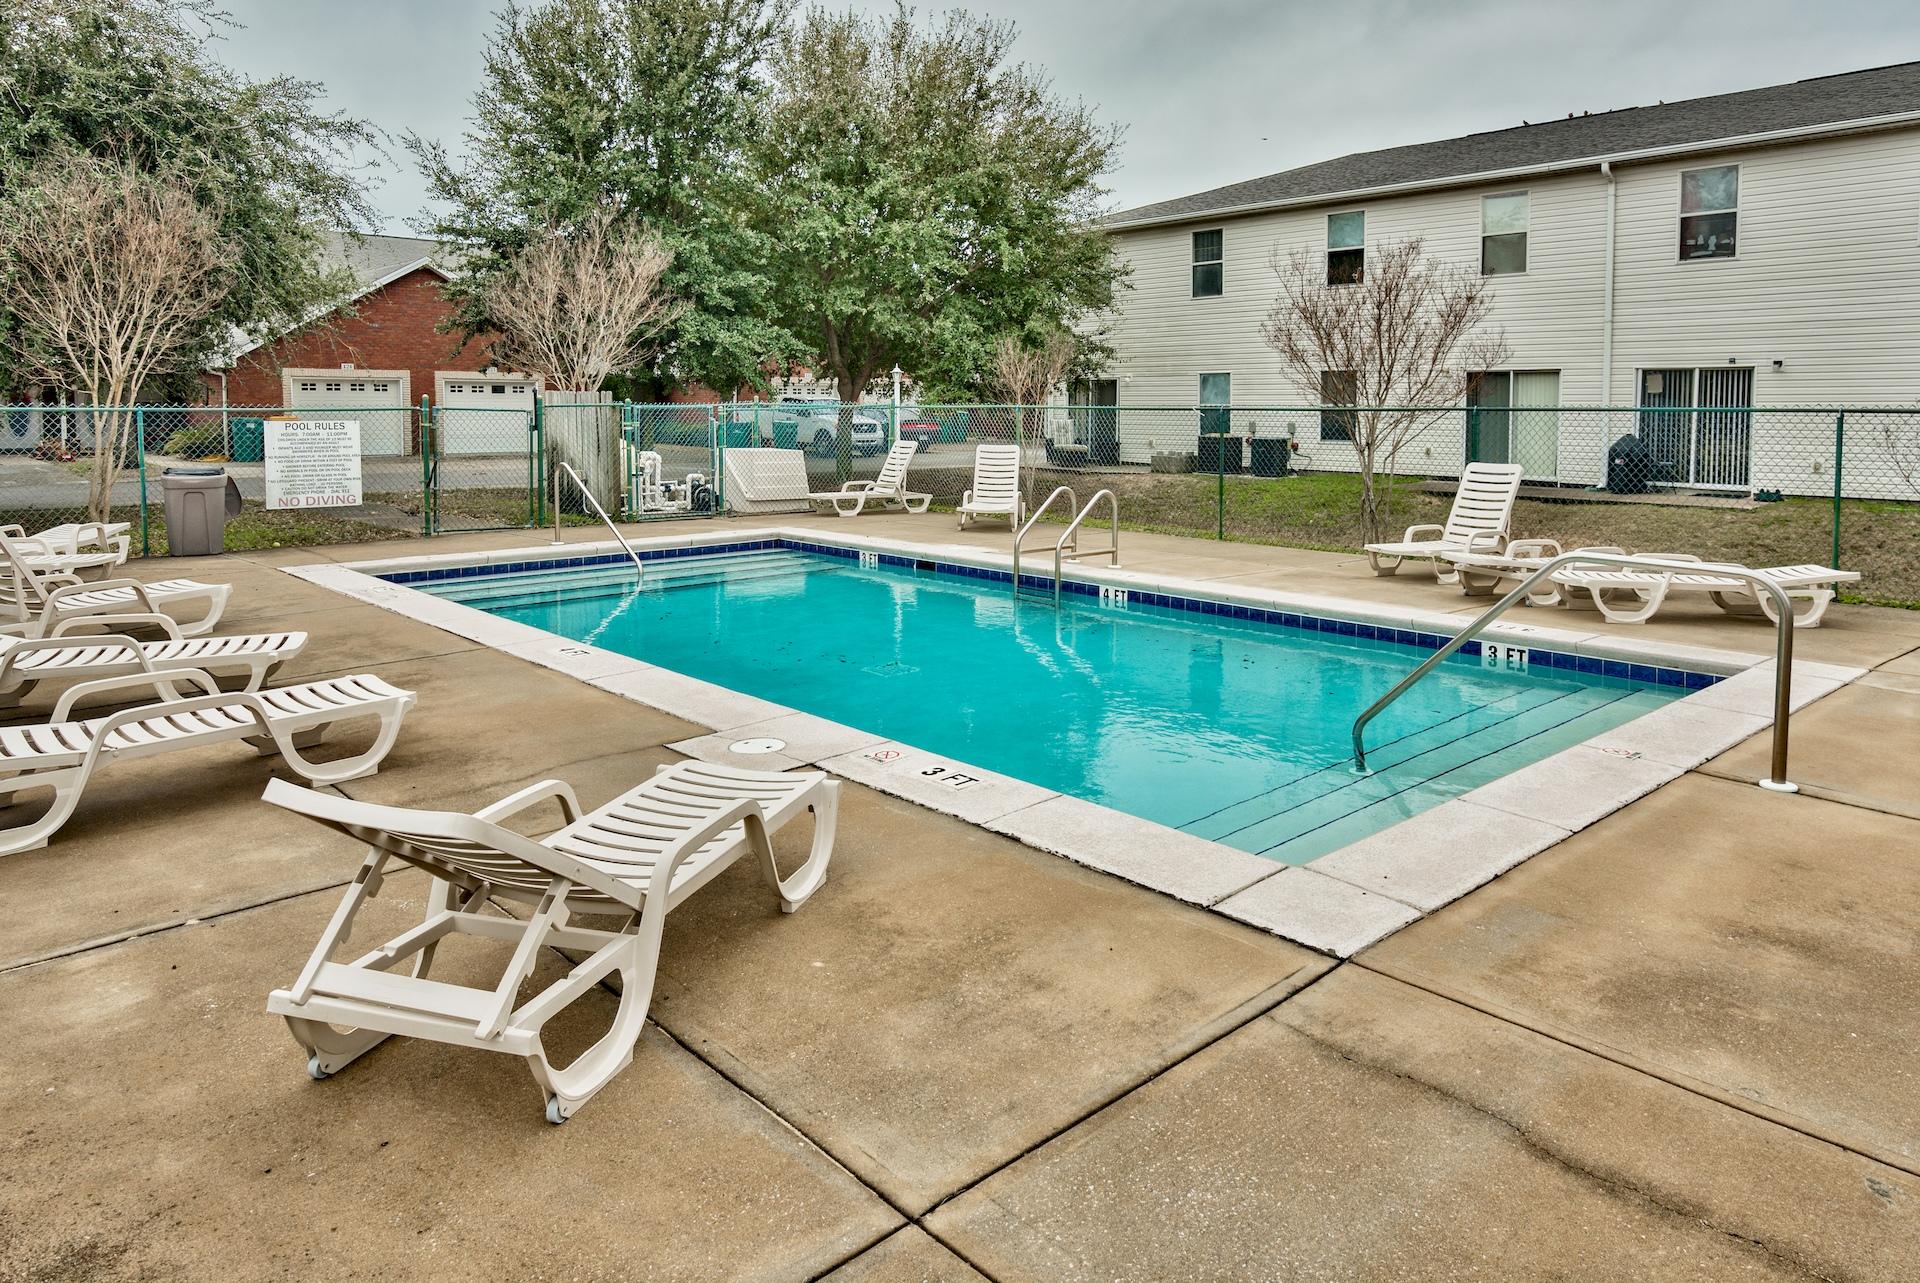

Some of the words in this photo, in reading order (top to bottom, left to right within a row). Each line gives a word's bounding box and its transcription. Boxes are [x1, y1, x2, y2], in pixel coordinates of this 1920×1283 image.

[278, 497, 300, 507] NO
[306, 495, 356, 506] DIVING
[1114, 590, 1126, 600] FT
[1488, 645, 1498, 658] 3
[1506, 647, 1526, 662] FT
[921, 766, 946, 776] 3
[941, 773, 980, 786] FT
